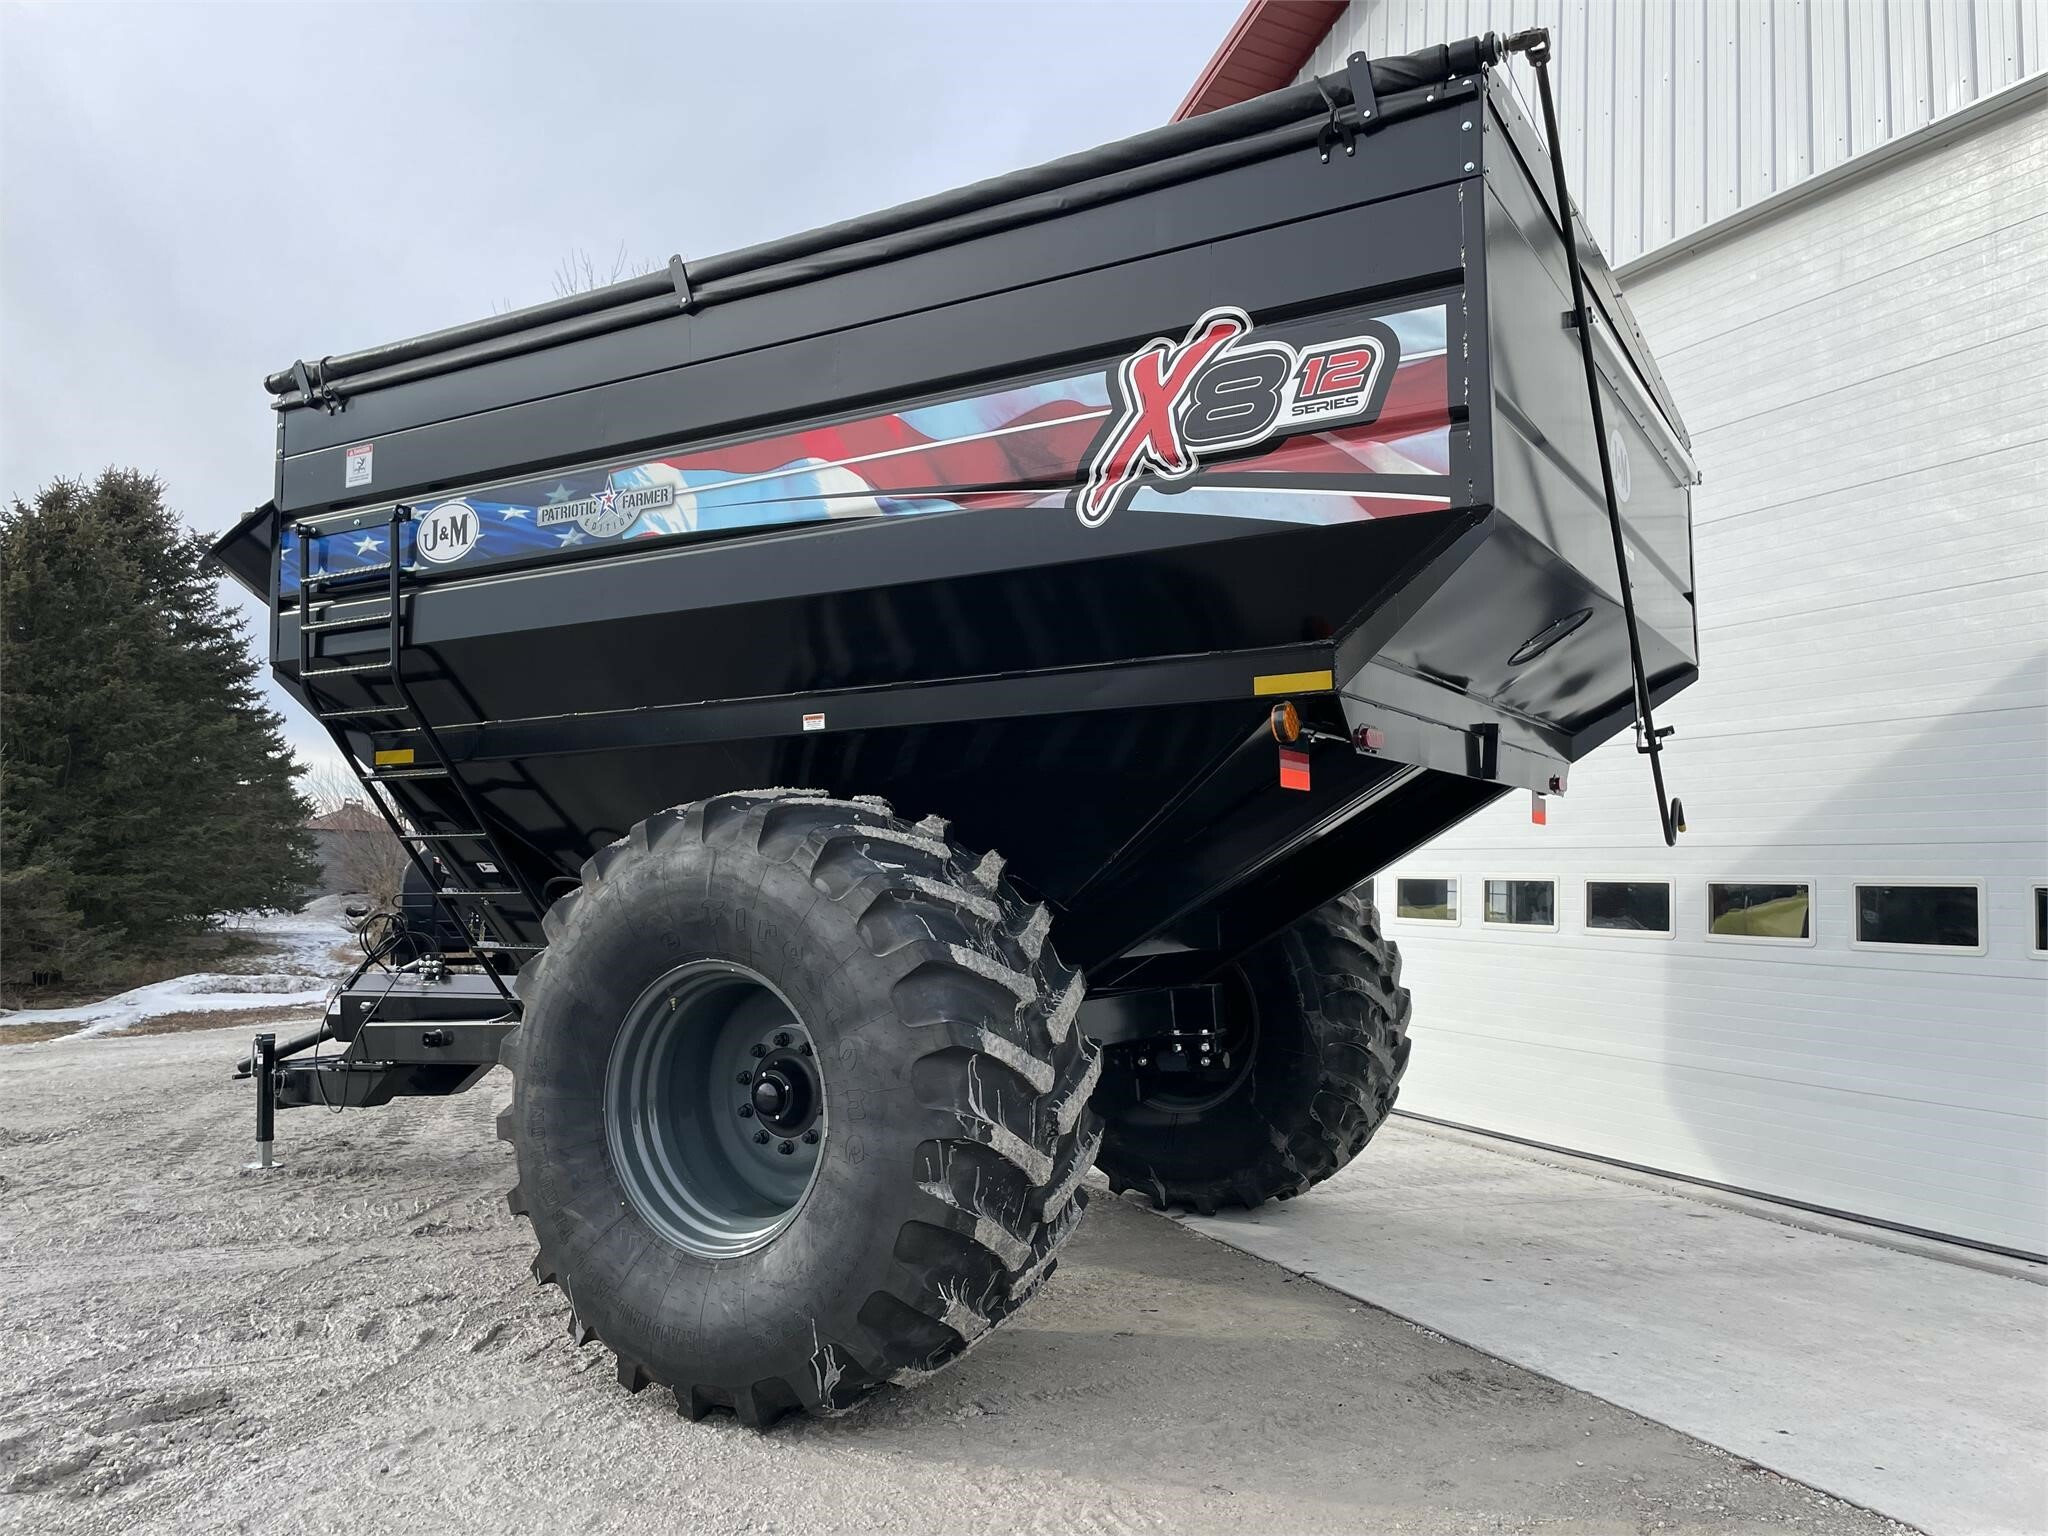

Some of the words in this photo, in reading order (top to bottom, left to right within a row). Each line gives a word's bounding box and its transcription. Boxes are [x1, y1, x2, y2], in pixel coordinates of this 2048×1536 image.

[1292, 395, 1359, 417] SERIES
[541, 500, 597, 522] PATRIOTIC
[622, 488, 669, 509] FARMER
[423, 513, 469, 551] J&M
[584, 511, 633, 532] EDITION
